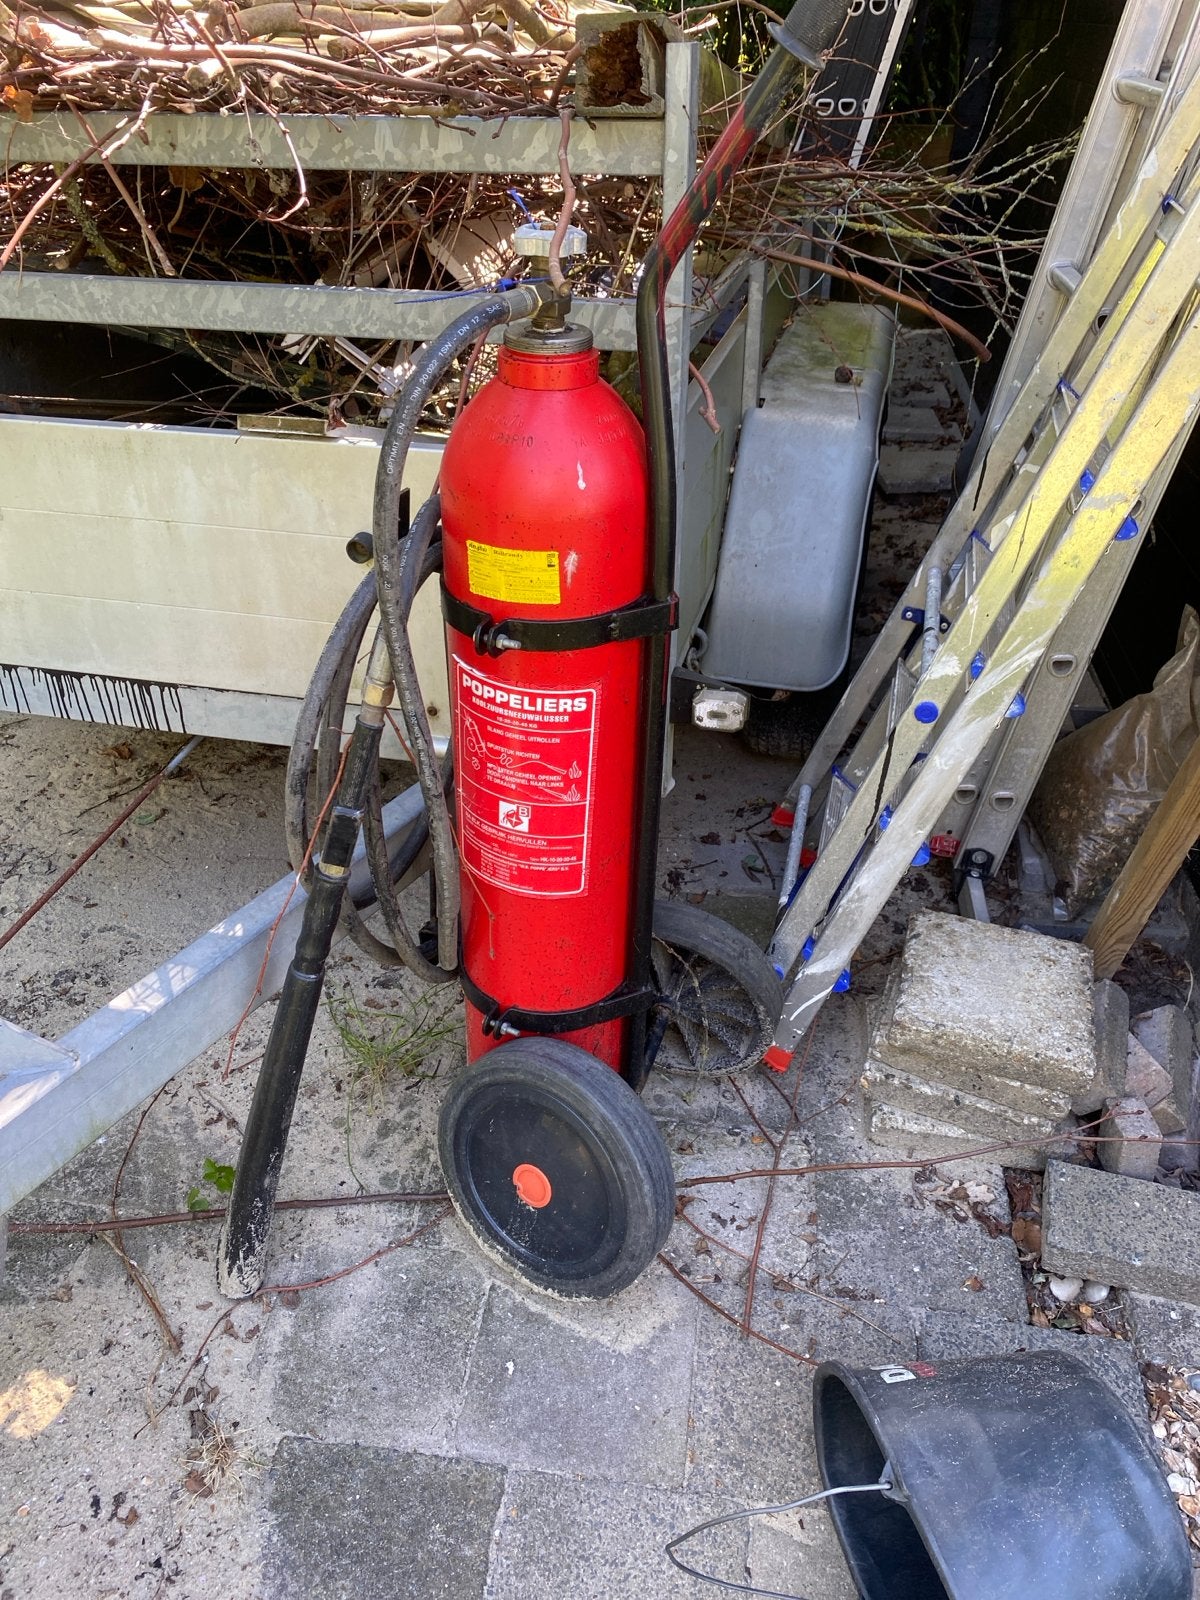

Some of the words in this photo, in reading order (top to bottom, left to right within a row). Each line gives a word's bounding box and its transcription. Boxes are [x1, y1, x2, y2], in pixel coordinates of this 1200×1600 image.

[386, 442, 400, 475] OPTIMIT
[396, 422, 407, 436] EN
[410, 386, 422, 402] DIN
[438, 341, 452, 358] 1SN
[457, 323, 470, 336] DN
[471, 316, 480, 325] 12
[486, 303, 502, 314] SAE
[462, 673, 587, 712] POPPELIERS
[504, 731, 526, 741] GEHEEL
[528, 736, 560, 744] UITROLLEN
[538, 774, 562, 782] OPENEN
[520, 808, 528, 816] B
[507, 834, 547, 846] HERVULLEN
